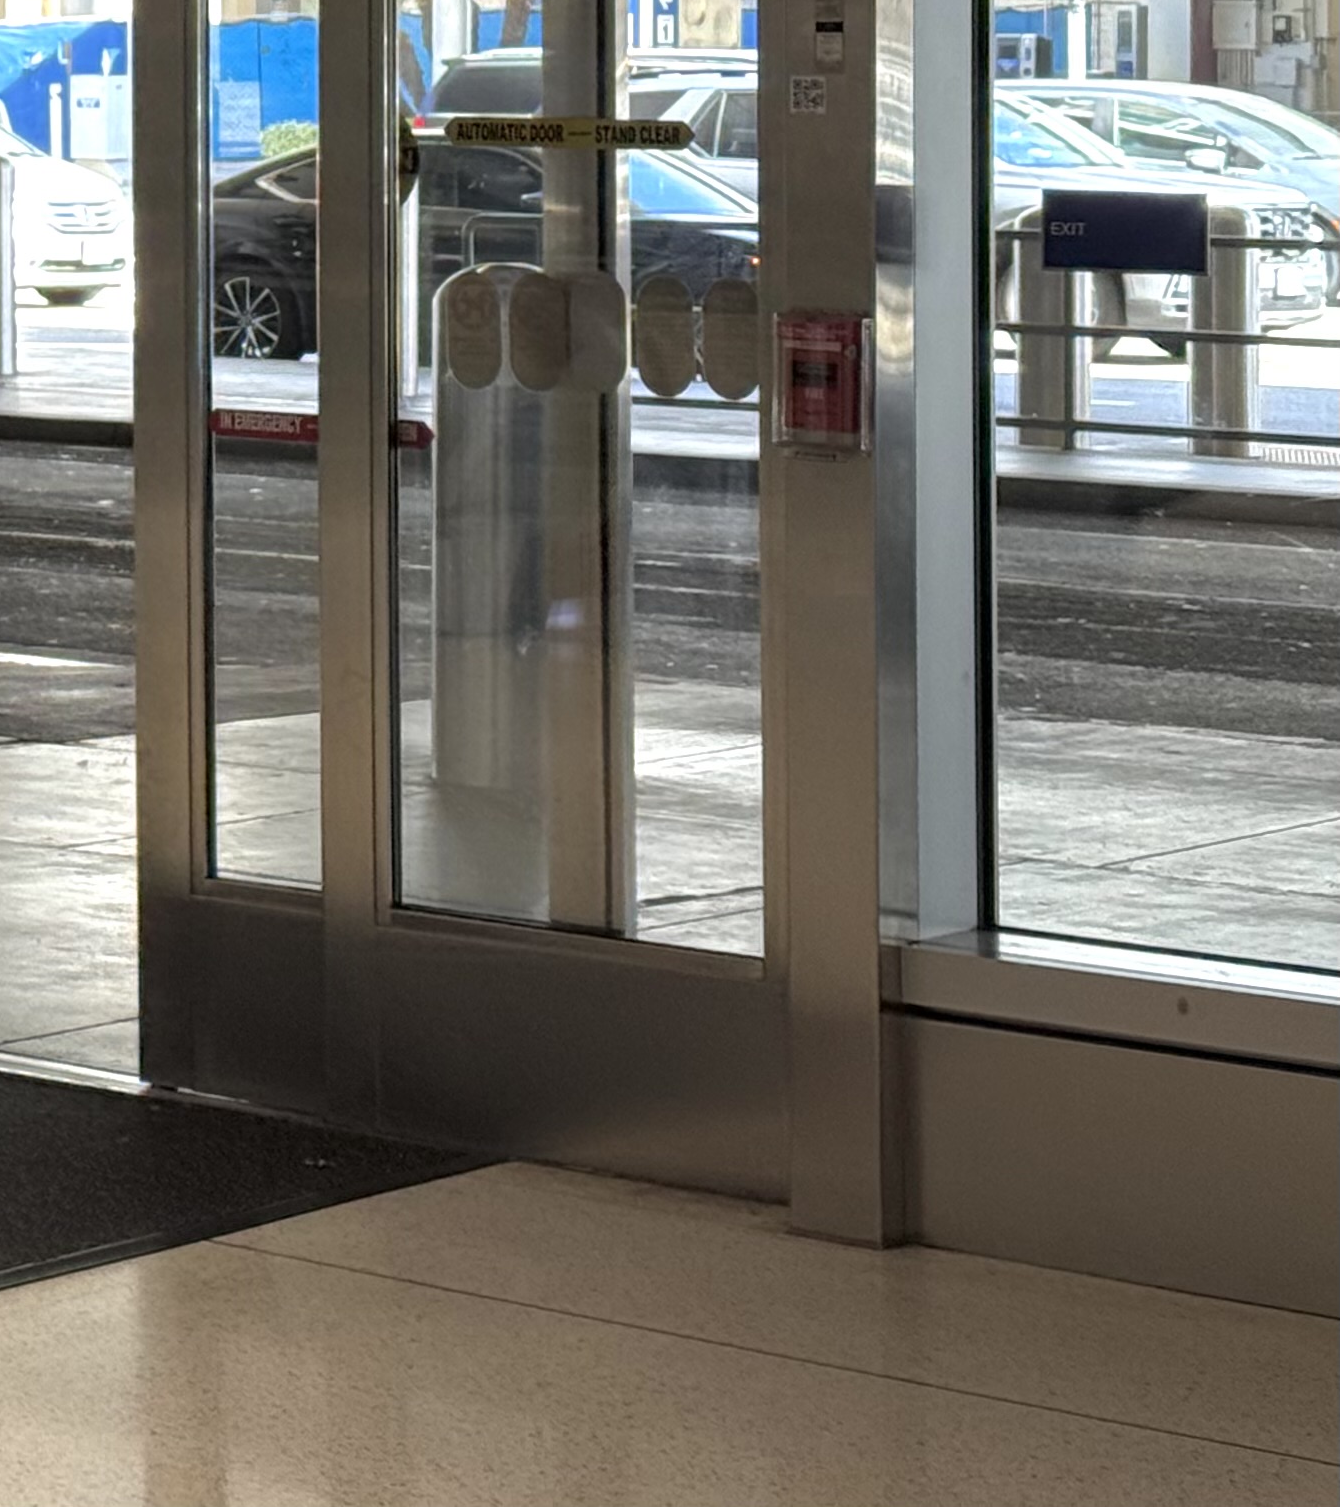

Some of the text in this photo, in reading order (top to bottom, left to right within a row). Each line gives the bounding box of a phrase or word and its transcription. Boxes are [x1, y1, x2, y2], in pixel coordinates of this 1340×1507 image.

[456, 123, 680, 144] AUTOMATIC DOOR STAND CLEAR
[1050, 222, 1085, 236] EXIT
[234, 412, 303, 434] EMERGENCY
